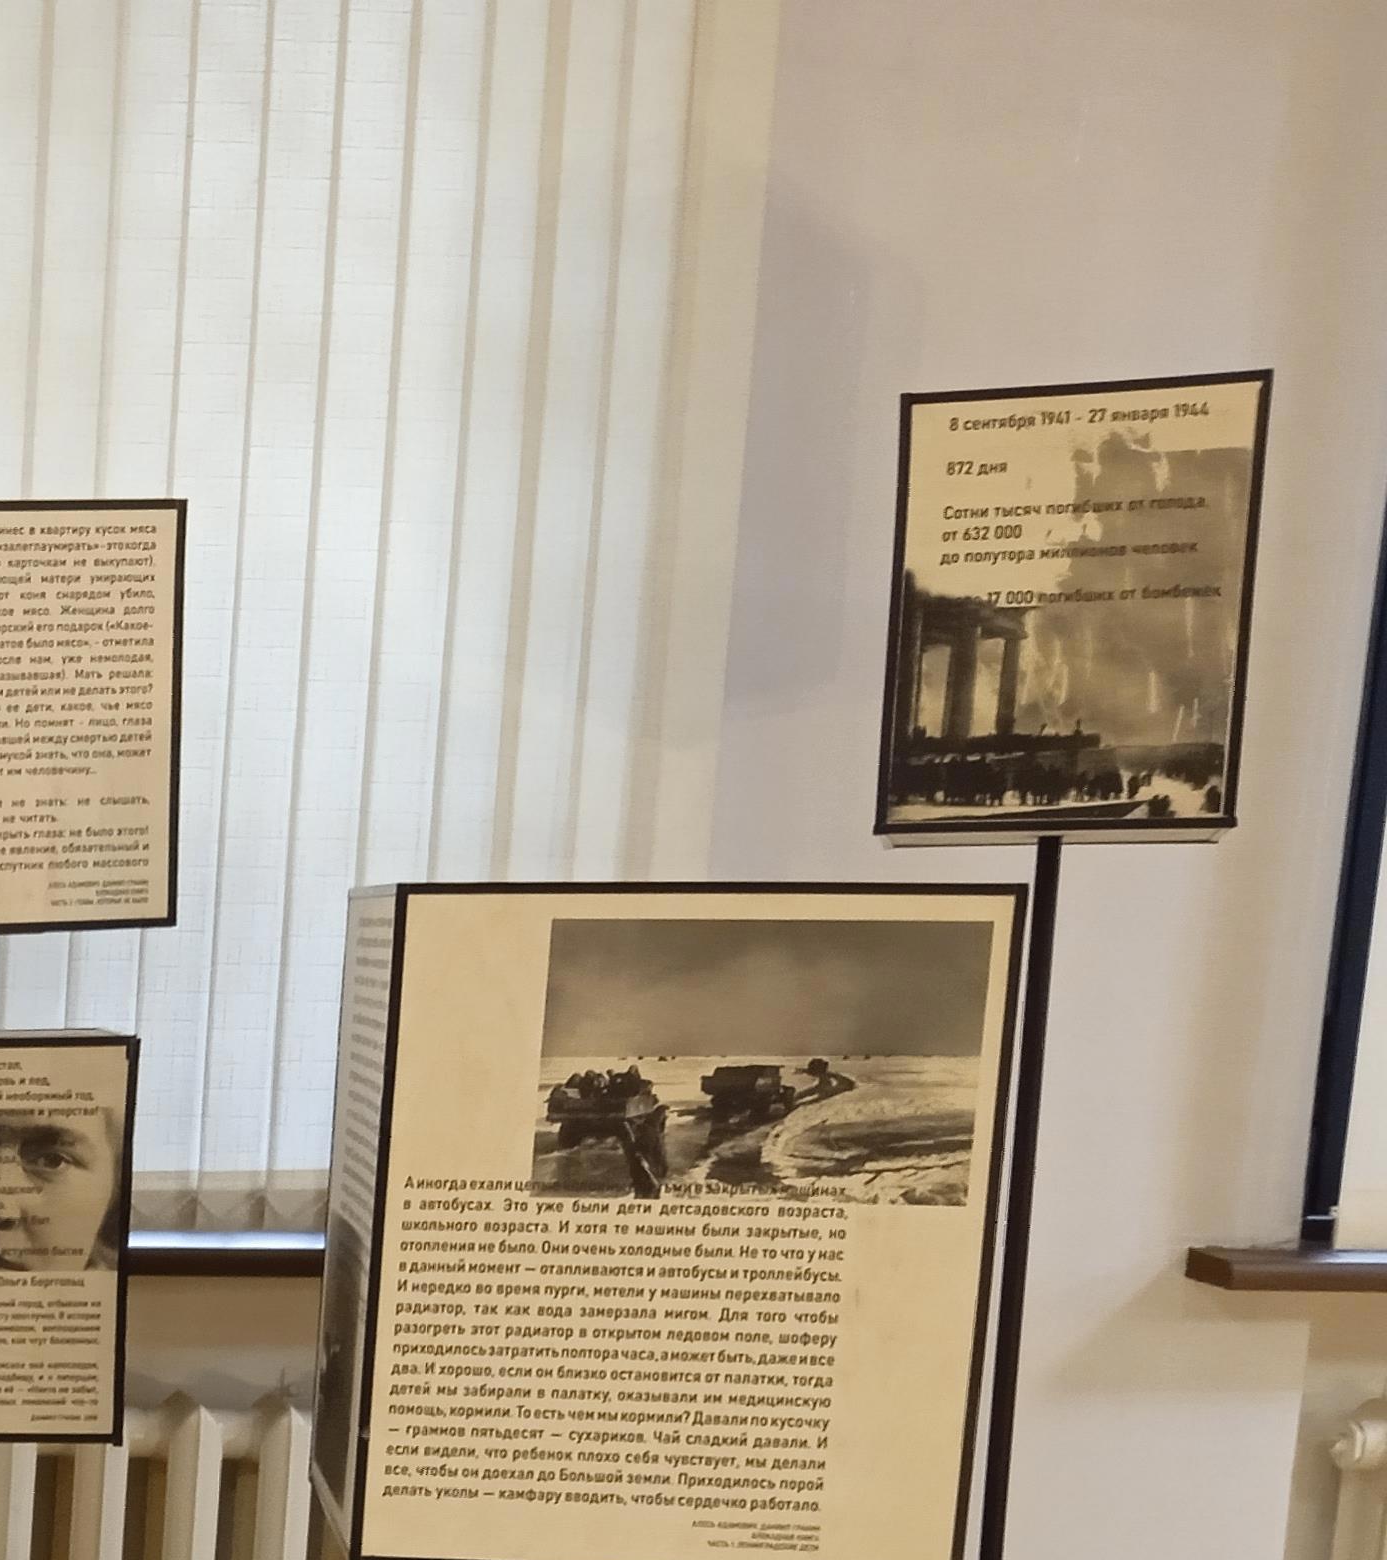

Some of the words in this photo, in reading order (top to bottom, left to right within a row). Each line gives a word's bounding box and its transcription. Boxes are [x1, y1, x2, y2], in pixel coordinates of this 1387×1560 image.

[947, 416, 959, 432] 8
[961, 413, 1036, 431] сентября
[1039, 409, 1071, 426] 1941
[1086, 407, 1108, 424] 27
[1109, 407, 1169, 422] января
[1172, 401, 1210, 418] 1944
[945, 459, 974, 476] 872
[975, 461, 1008, 477] дня
[942, 504, 989, 520] Сотни
[994, 503, 1042, 518] тысяч
[1045, 499, 1123, 517] погибших
[940, 529, 959, 543] от
[961, 524, 990, 541] 632
[992, 523, 1022, 540] 000
[939, 551, 960, 566] до
[963, 548, 1035, 567] полутора
[1005, 591, 1034, 605] 000
[402, 1198, 412, 1210] в
[502, 1196, 528, 1212] Это
[535, 1201, 564, 1216] уже
[570, 1198, 610, 1213] были
[615, 1202, 652, 1216] дети
[657, 1202, 770, 1217] детсадовского
[776, 1205, 849, 1221] возраста,
[387, 1380, 432, 1397] детей
[435, 1384, 458, 1396] мы
[462, 1382, 532, 1401] забирали
[536, 1387, 546, 1399] в
[550, 1387, 612, 1404] палатку,
[616, 1390, 698, 1404] оказывали
[702, 1393, 723, 1404] им
[727, 1393, 832, 1411] медицинскую
